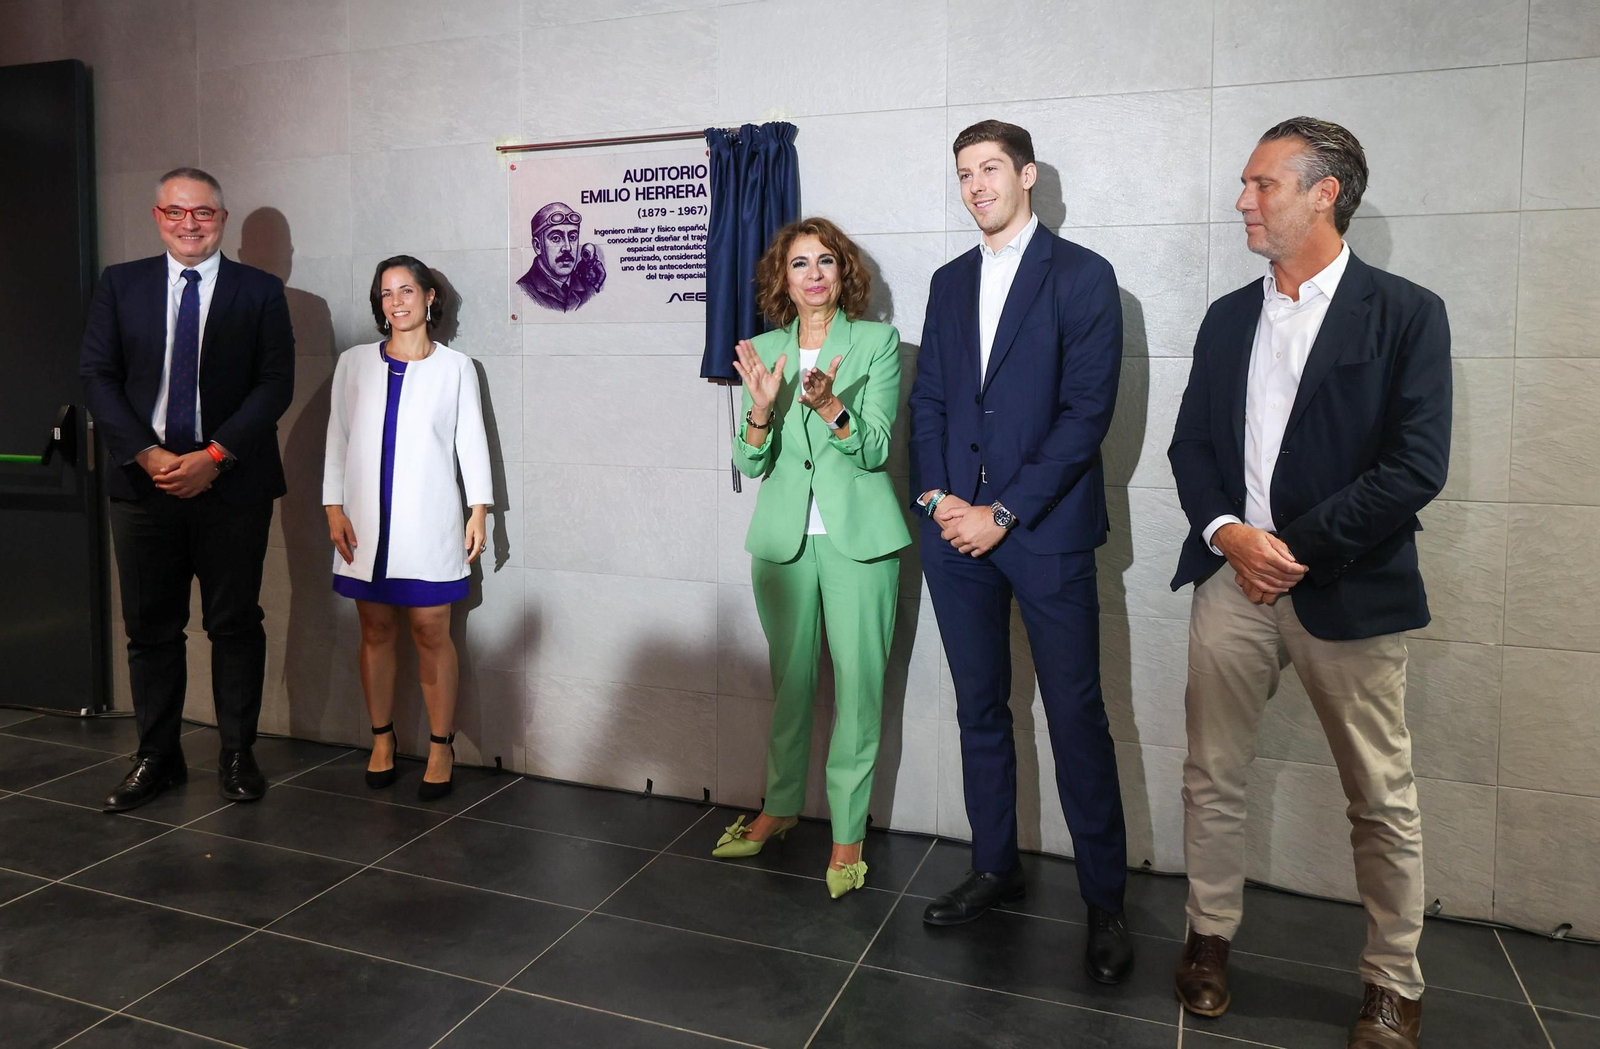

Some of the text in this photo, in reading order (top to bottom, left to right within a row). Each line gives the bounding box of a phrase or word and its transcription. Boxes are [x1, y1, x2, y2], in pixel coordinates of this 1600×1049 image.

[623, 164, 708, 184] AUDITORIO
[580, 183, 708, 204] EMILIO HERRERA
[637, 207, 667, 219] (1879
[677, 205, 708, 216] 1967)
[594, 228, 625, 236] Ingeniero
[627, 226, 648, 234] militar
[678, 224, 707, 232] español,
[607, 236, 638, 244] conocido
[691, 232, 707, 242] traje
[626, 242, 706, 253] espacial estratonáutico
[620, 252, 706, 263] presurizado, considerado
[658, 272, 674, 281] traje
